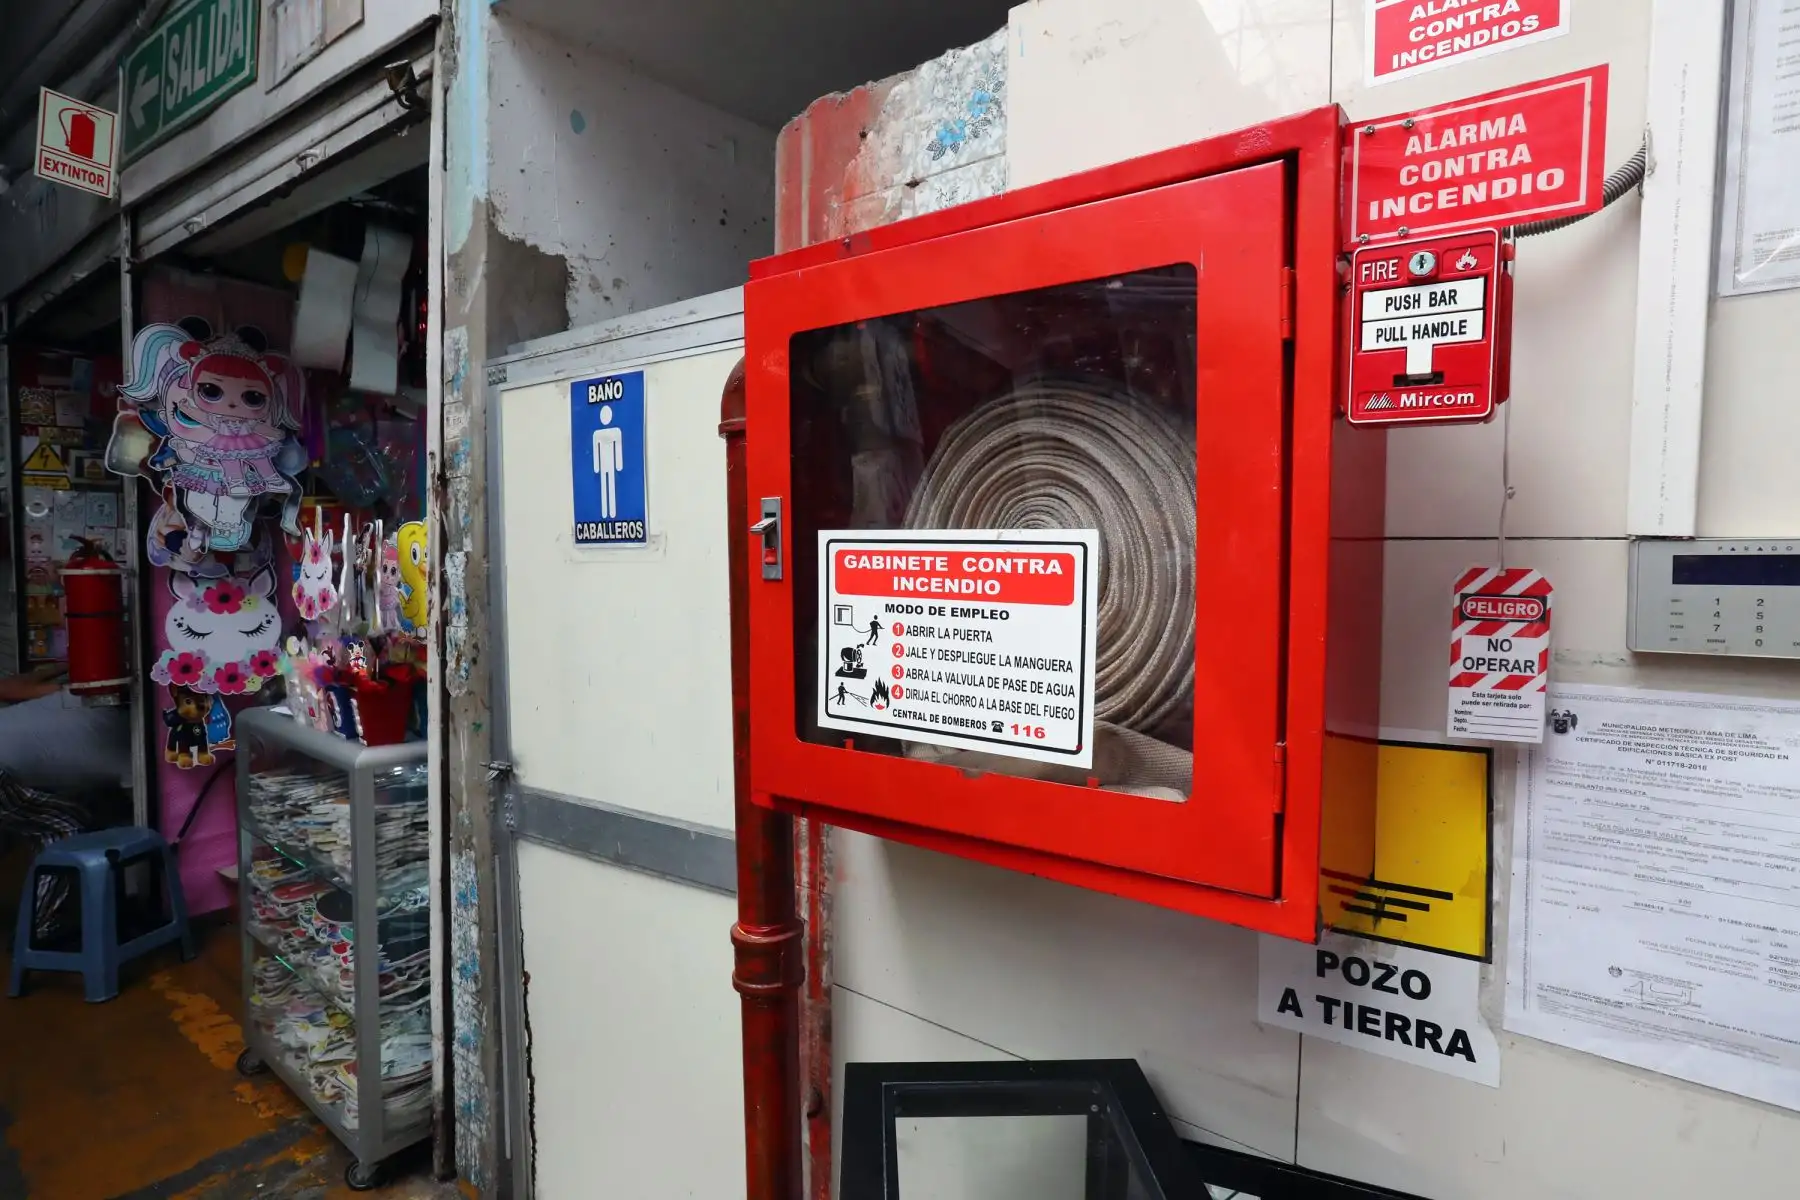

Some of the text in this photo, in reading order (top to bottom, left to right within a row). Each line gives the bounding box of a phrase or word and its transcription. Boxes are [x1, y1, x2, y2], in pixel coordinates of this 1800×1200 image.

[1409, 0, 1520, 42] CONTRA
[1392, 15, 1539, 69] INCENDIOS
[166, 0, 244, 110] SALIDA
[1405, 113, 1527, 156] ALARMA
[43, 157, 104, 187] EXTINTOR
[1400, 143, 1532, 186] CONTRA
[1368, 168, 1564, 220] INCENDIO
[1361, 259, 1399, 282] FIRE
[1385, 289, 1458, 312] PUSH BAR
[1376, 319, 1467, 343] PULL HANDLE
[588, 379, 623, 403] BAÑO
[1400, 392, 1475, 407] Mircom
[576, 521, 643, 539] CABALLEROS
[844, 555, 1063, 575] GABINETE CONTRA
[893, 576, 1001, 595] INCENDIO
[885, 603, 1009, 621] MODO DE EMPLEO
[1466, 601, 1539, 616] PELIGRO
[1757, 598, 1764, 607] 2
[906, 625, 935, 638] ABRIR
[937, 626, 950, 639] LA
[952, 627, 993, 643] PUERTA
[1713, 624, 1720, 632] 7
[1487, 638, 1512, 652] NO
[905, 646, 928, 660] JALE
[929, 648, 936, 660] Y
[938, 648, 996, 666] DESPLIEGUE
[998, 654, 1012, 667] LA
[1014, 655, 1073, 673] MANGUERA
[1462, 656, 1536, 674] OPERAR
[906, 668, 929, 682] ABRA
[931, 670, 944, 683] LA
[945, 671, 986, 688] VALVULA
[987, 676, 1000, 689] DE
[1002, 677, 1028, 692] PASE
[1030, 680, 1044, 694] DE
[1045, 682, 1075, 698] AGUA
[905, 687, 929, 702] DIRIJA
[931, 690, 941, 703] EL
[942, 691, 977, 708] CHORRO
[978, 695, 985, 708] A
[986, 696, 997, 710] LA
[999, 698, 1022, 713] BASE
[1024, 701, 1042, 715] DEL
[1044, 704, 1075, 721] FUEGO
[1487, 692, 1506, 700] tarjeta
[892, 708, 1046, 739] CENTRAL DE BOMBEROS 116
[1602, 722, 1657, 732] MUNICIPALIDAD
[1659, 727, 1723, 737] METROPOLITANA
[1576, 736, 1621, 746] CERTIFICADO
[1728, 749, 1775, 759] SEGURIDAD
[1617, 746, 1673, 756] EDIFICACIONES
[1316, 949, 1431, 1000] POZO
[1277, 987, 1303, 1018] A
[1315, 994, 1477, 1063] TIERRA
